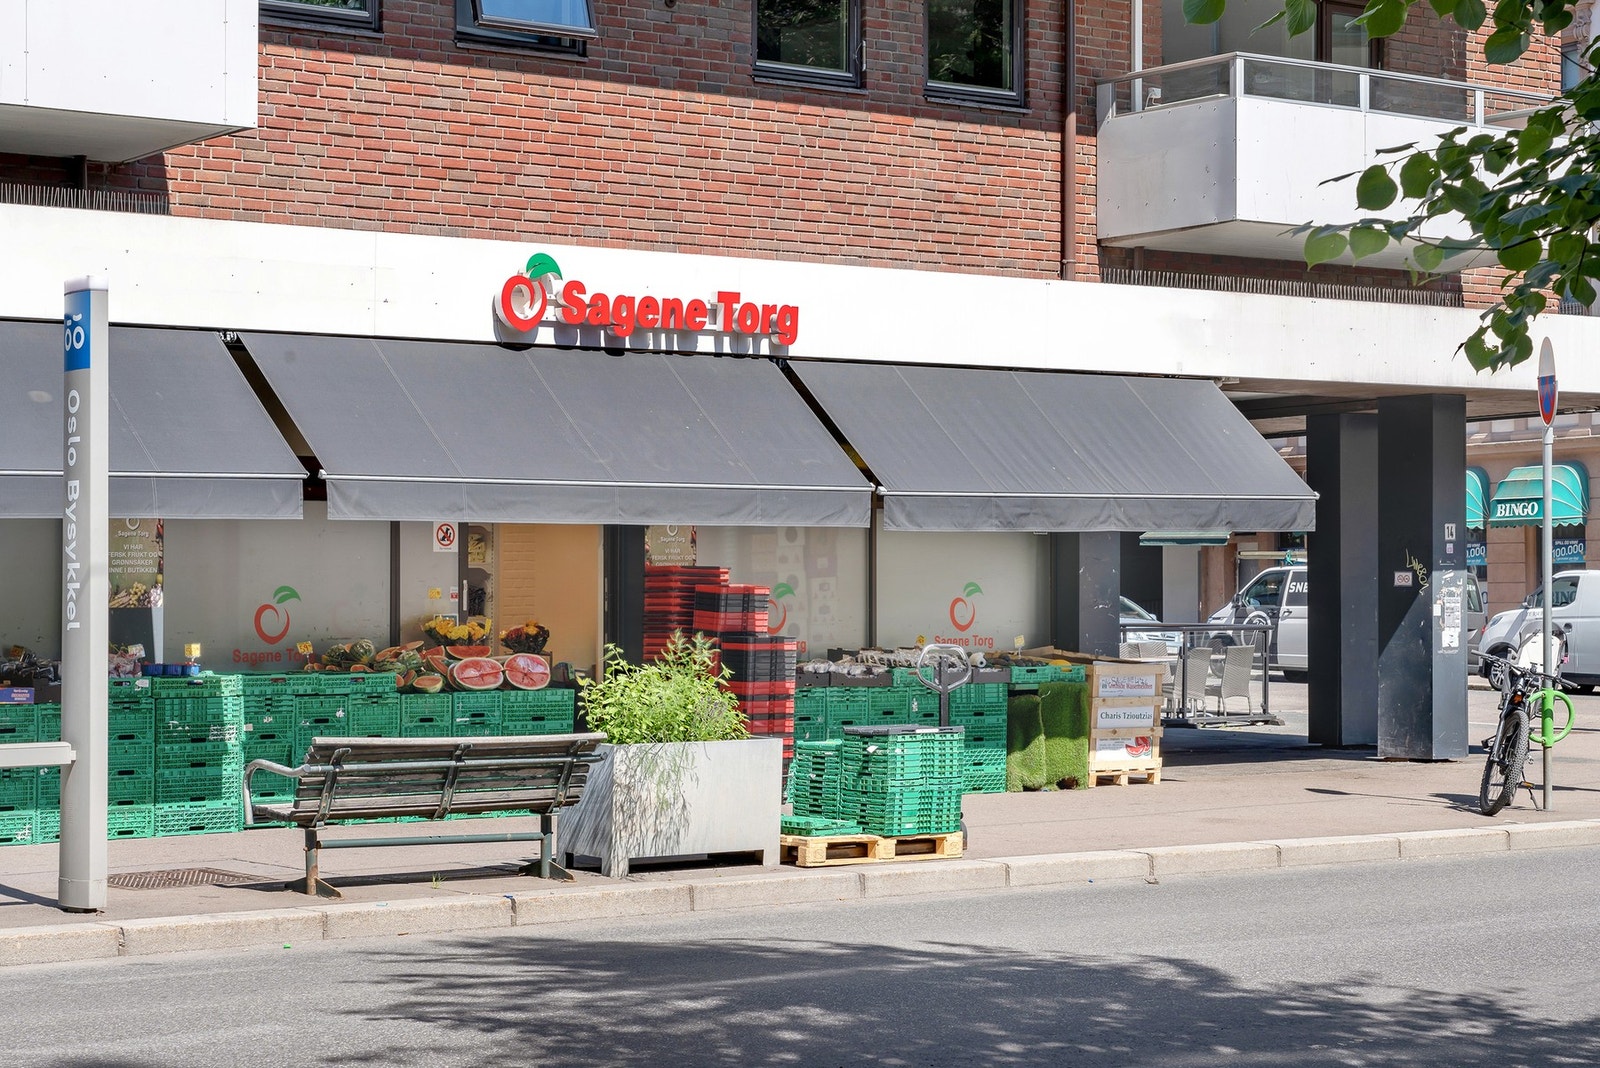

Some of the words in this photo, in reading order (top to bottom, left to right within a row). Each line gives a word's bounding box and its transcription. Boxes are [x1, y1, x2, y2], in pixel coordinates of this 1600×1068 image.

[560, 280, 708, 338] Sagene
[716, 290, 800, 347] Torg
[67, 389, 81, 467] Oslo
[1496, 501, 1539, 517] BINGO
[1446, 525, 1454, 539] 14
[64, 480, 81, 631] Bysykkel
[1552, 542, 1584, 558] 100.000
[972, 635, 994, 647] Torg
[232, 649, 281, 666] Sagene
[1100, 711, 1121, 720] Charis
